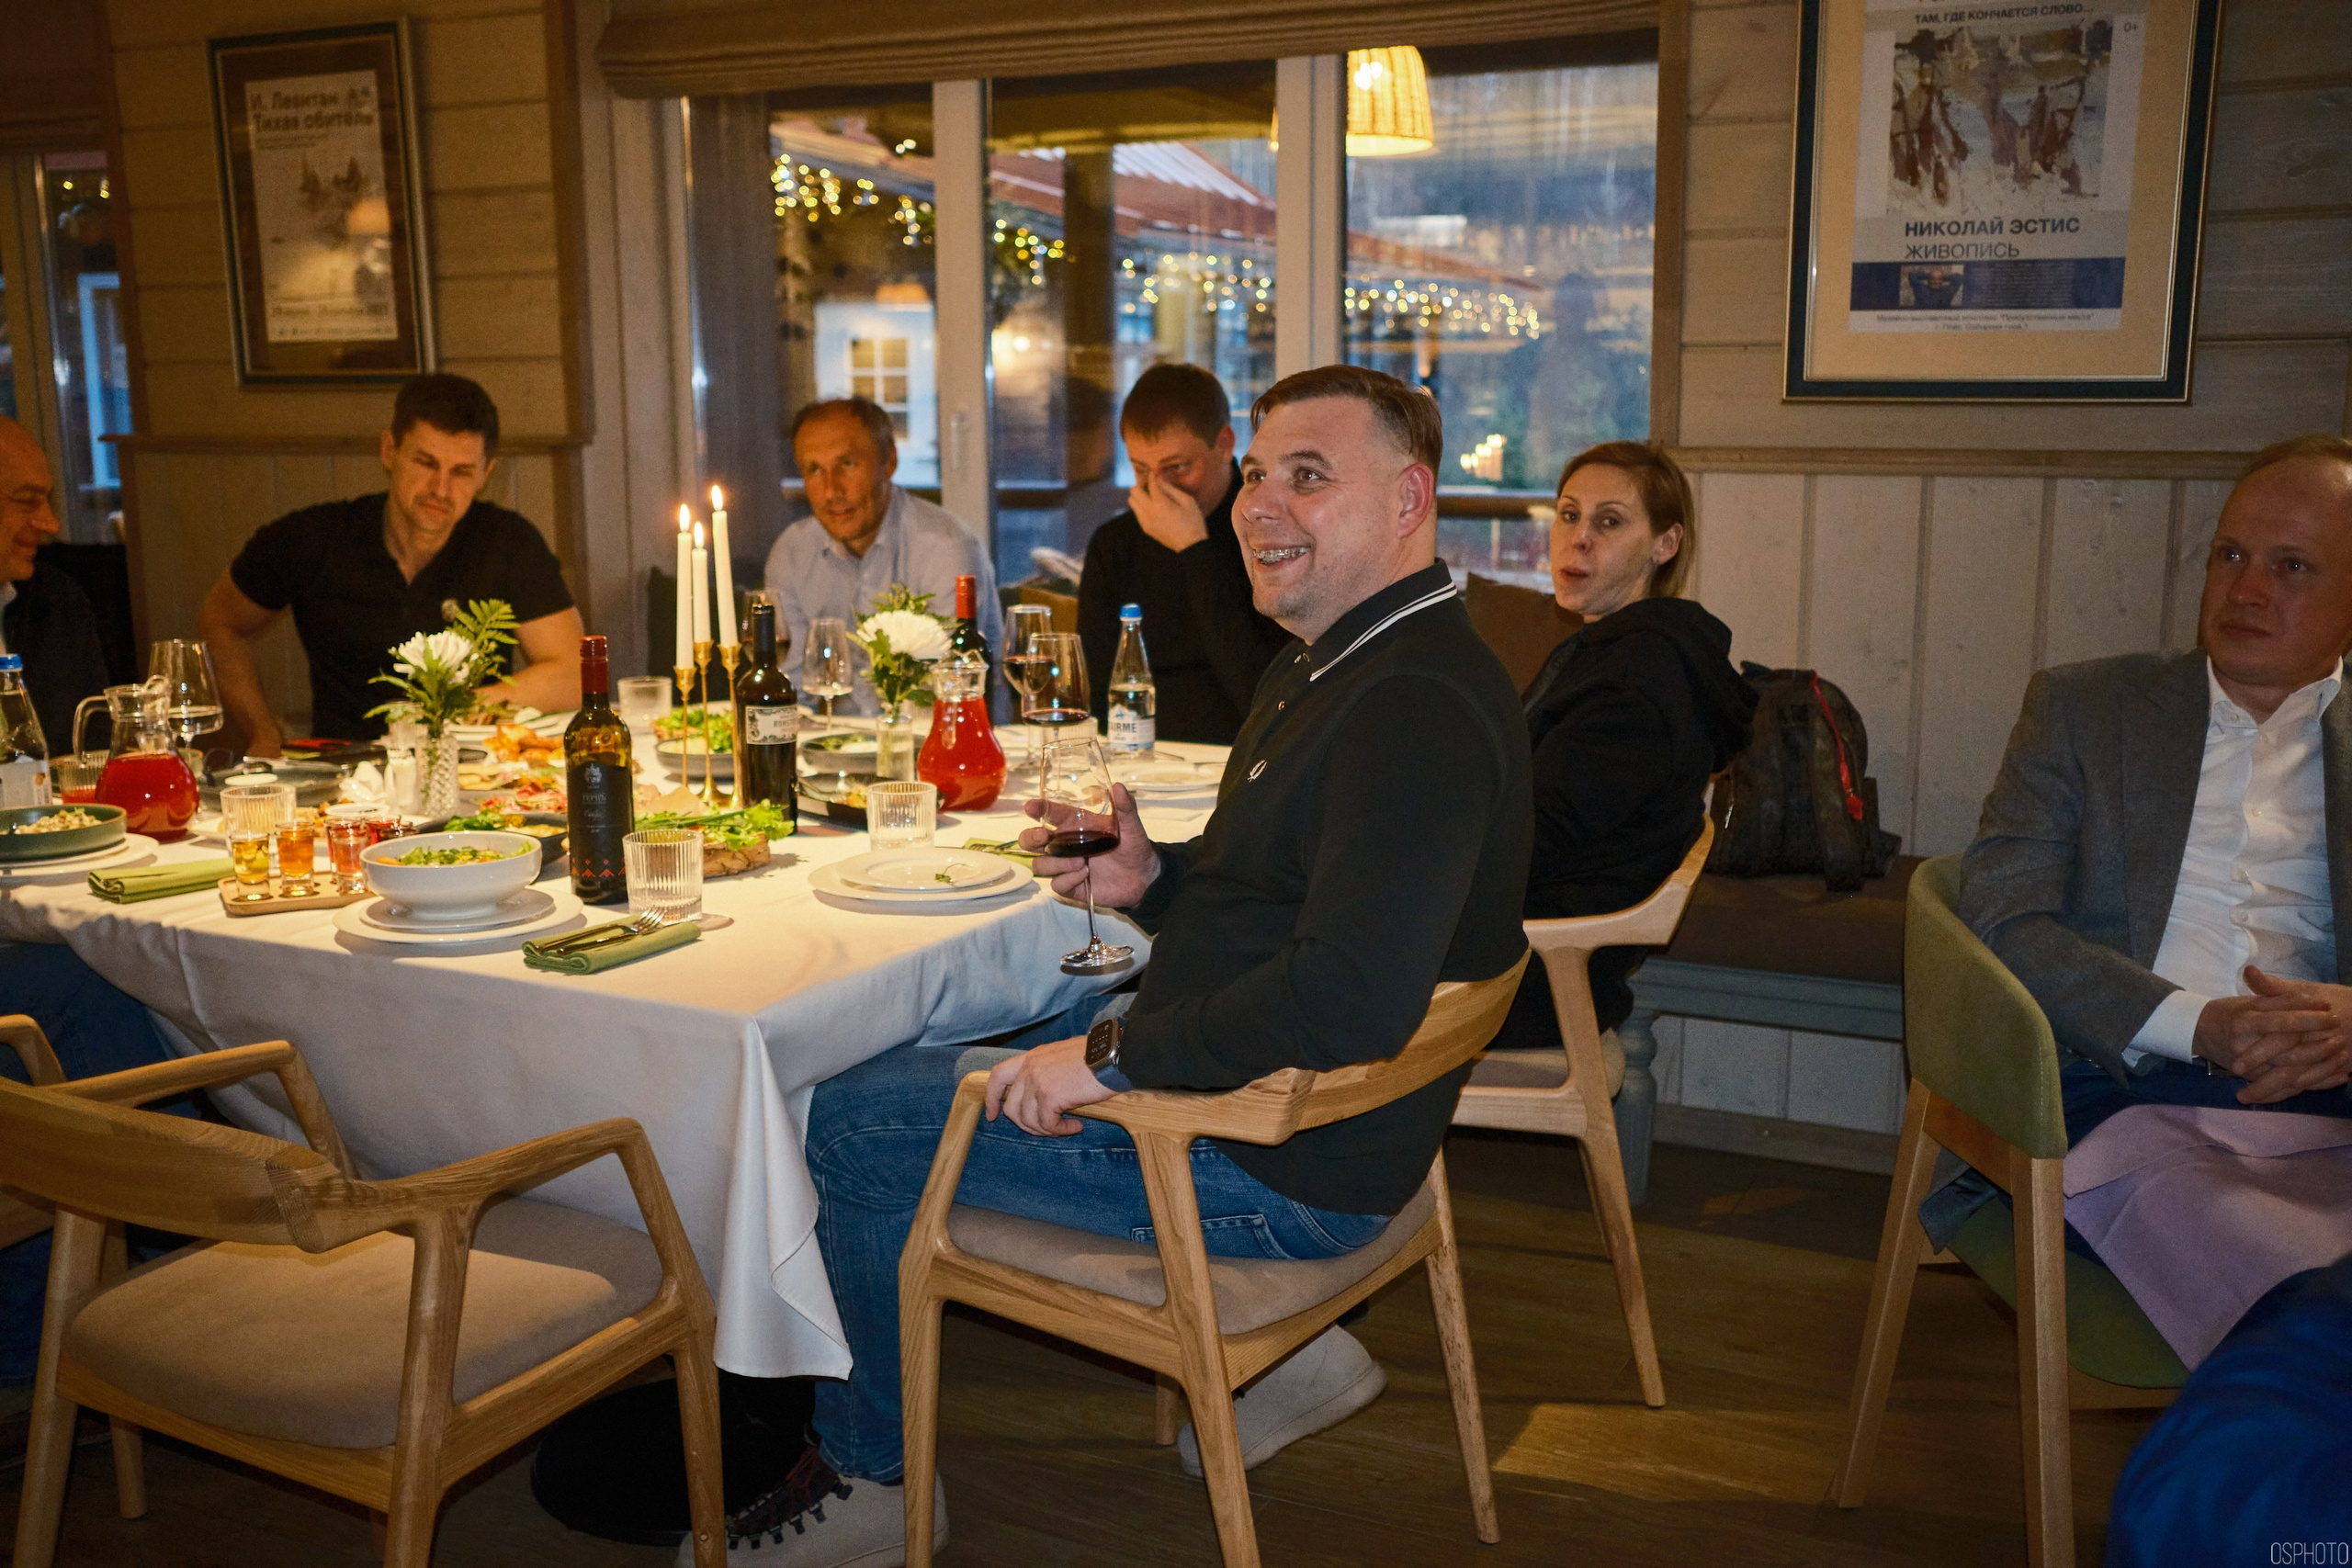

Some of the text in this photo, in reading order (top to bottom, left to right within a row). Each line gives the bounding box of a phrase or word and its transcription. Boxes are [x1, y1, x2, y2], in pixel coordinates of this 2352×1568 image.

[1942, 12, 1965, 23] ГДЕ
[1967, 7, 2038, 21] КОНЧАЕТСЯ
[2124, 23, 2139, 33] 0+
[1905, 217, 2080, 236] НИКОЛАЙ ЭСТИС
[1905, 243, 2020, 260] ЖИВОПИСЬ
